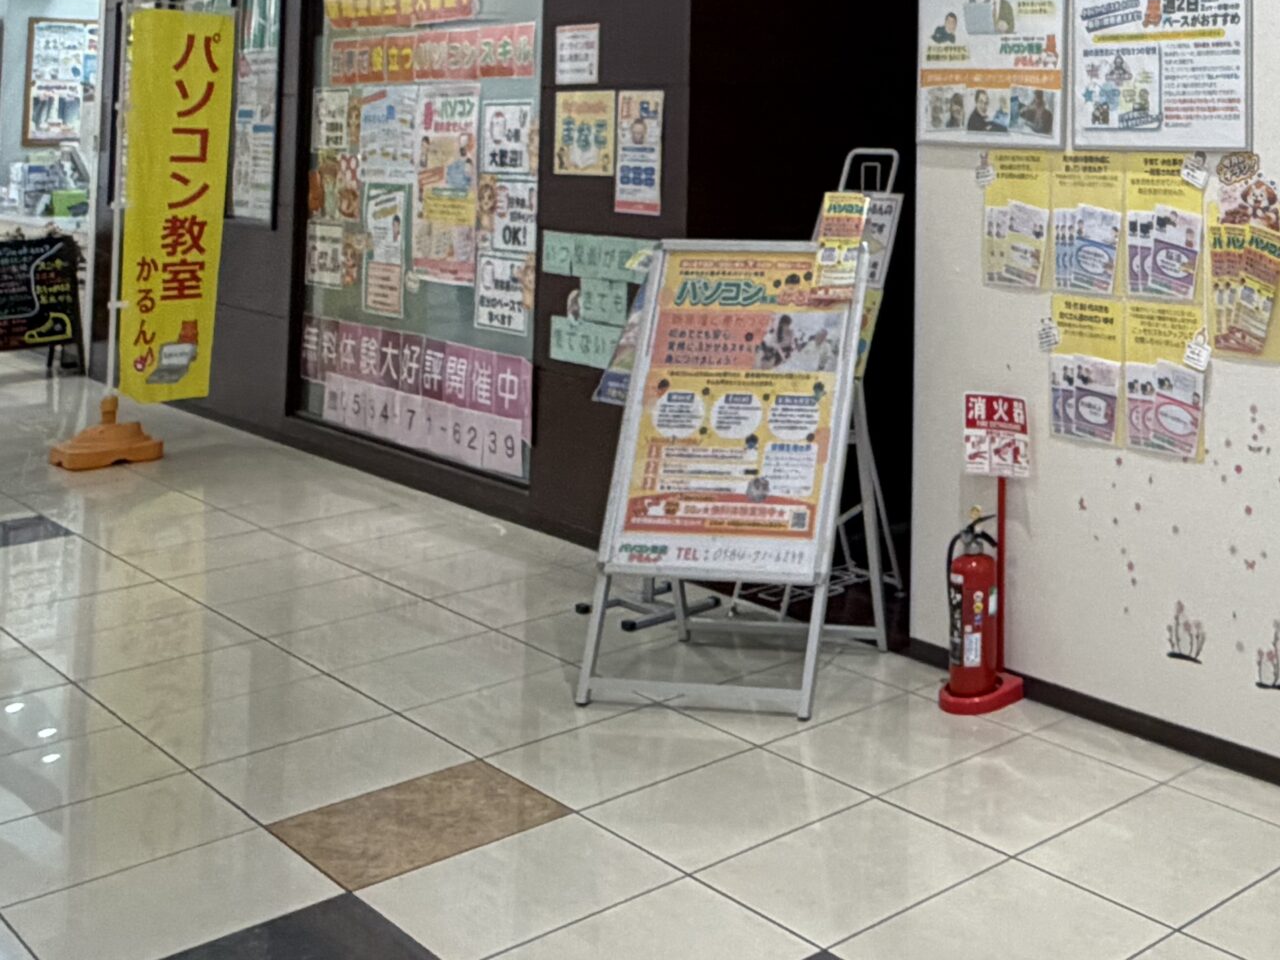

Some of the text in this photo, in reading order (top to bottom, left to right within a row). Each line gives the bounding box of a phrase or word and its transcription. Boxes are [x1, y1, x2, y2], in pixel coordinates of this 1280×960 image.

[1163, 13, 1241, 28] ペースがおすすめ
[160, 32, 222, 303] パソコン教室
[133, 256, 159, 347] かるん
[968, 396, 1025, 425] 消火器
